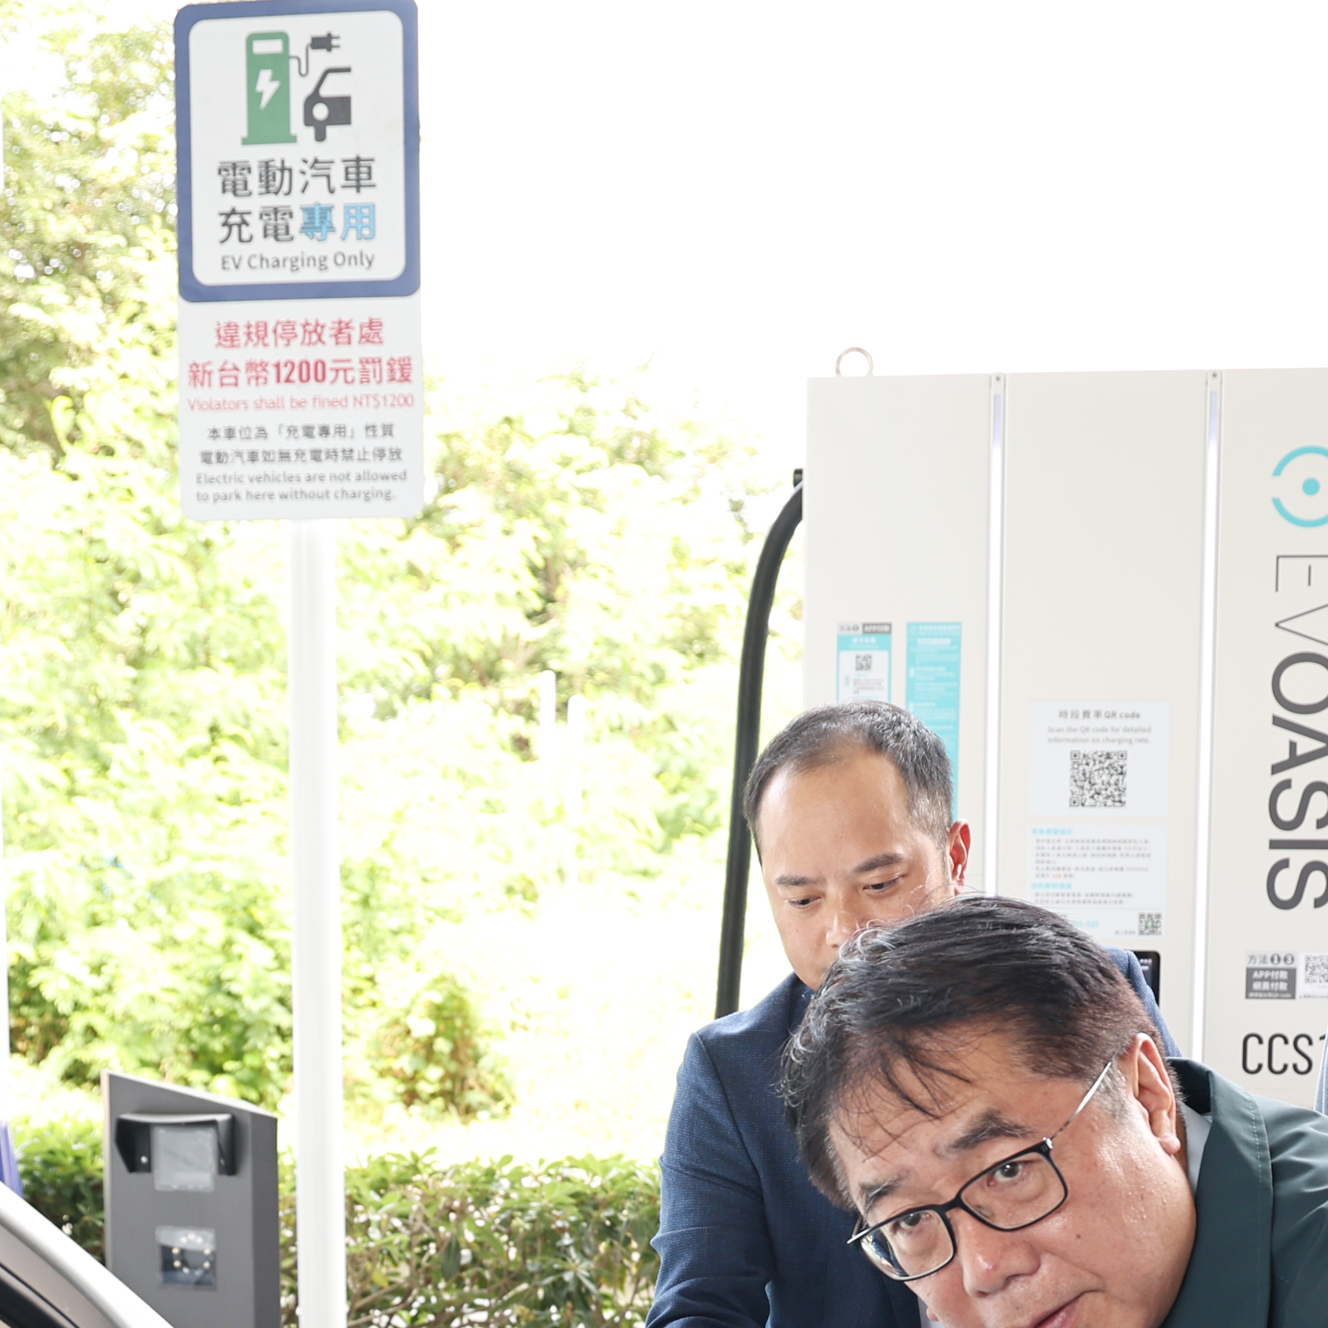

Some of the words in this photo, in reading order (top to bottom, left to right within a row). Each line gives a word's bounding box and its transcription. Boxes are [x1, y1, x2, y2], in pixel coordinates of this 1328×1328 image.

[218, 155, 376, 198] 電動汽車
[218, 202, 376, 245] 充電專用
[222, 255, 242, 270] EV
[247, 251, 328, 272] Charging
[333, 250, 375, 270] Only
[215, 317, 385, 349] 違規停放者處
[187, 355, 413, 389] 新台幣1200元罰鍰
[188, 397, 250, 413] Violators
[253, 396, 285, 411] shall
[290, 395, 307, 410] be
[312, 394, 348, 410] fined
[353, 393, 415, 410] NT$1200
[199, 448, 403, 465] 電動汽車如無充電時禁止停放
[196, 473, 244, 485] Electric
[248, 471, 301, 484] vehicles
[304, 473, 325, 482] are
[329, 471, 351, 482] not
[355, 469, 407, 481] allowed
[197, 491, 209, 501] to
[212, 488, 241, 504] park
[246, 488, 274, 500] here
[279, 487, 330, 500] without
[333, 487, 397, 501] charging.
[1241, 1032, 1326, 1075] CCS
